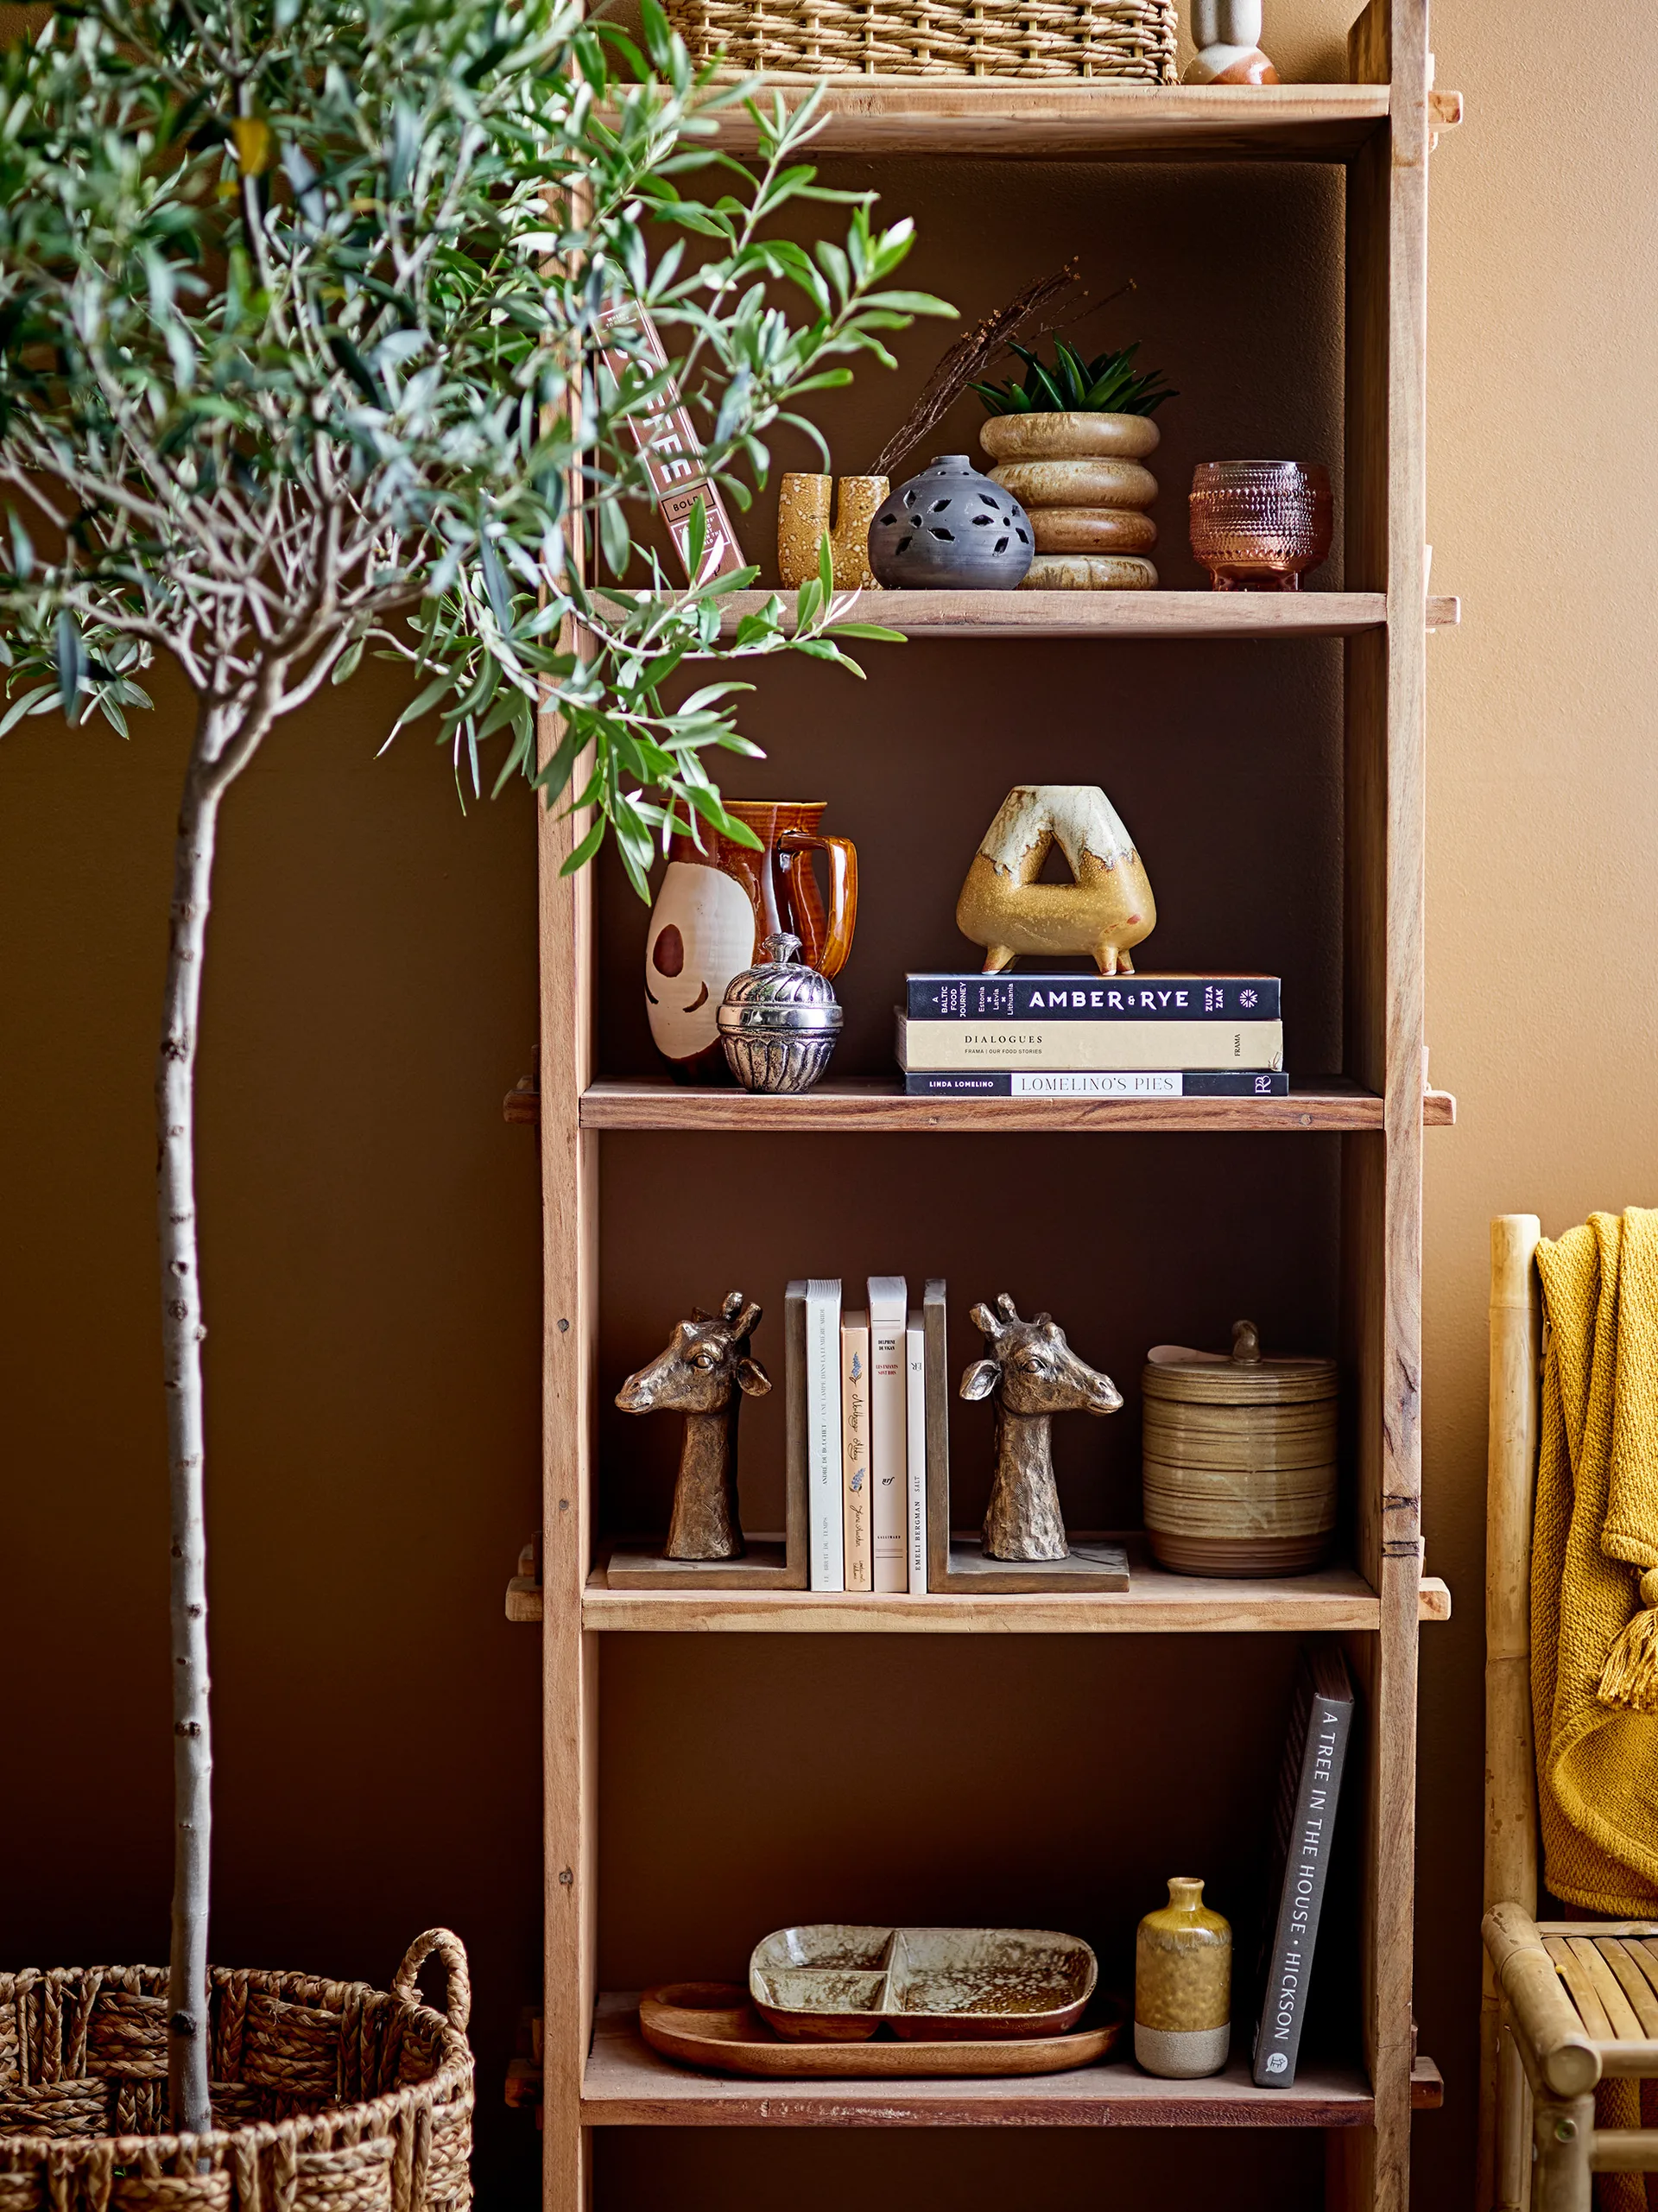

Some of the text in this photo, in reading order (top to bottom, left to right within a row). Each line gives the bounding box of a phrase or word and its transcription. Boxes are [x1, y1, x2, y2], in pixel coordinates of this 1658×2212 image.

[1028, 991, 1189, 1011] AMBER & RYE
[1205, 986, 1213, 1012] ZUZA
[1215, 989, 1224, 1009] ZAK
[1021, 1077, 1174, 1091] LOMELINO'S PIES
[1274, 1711, 1338, 2040] A TREE IN THE HOUSE HICKSON
